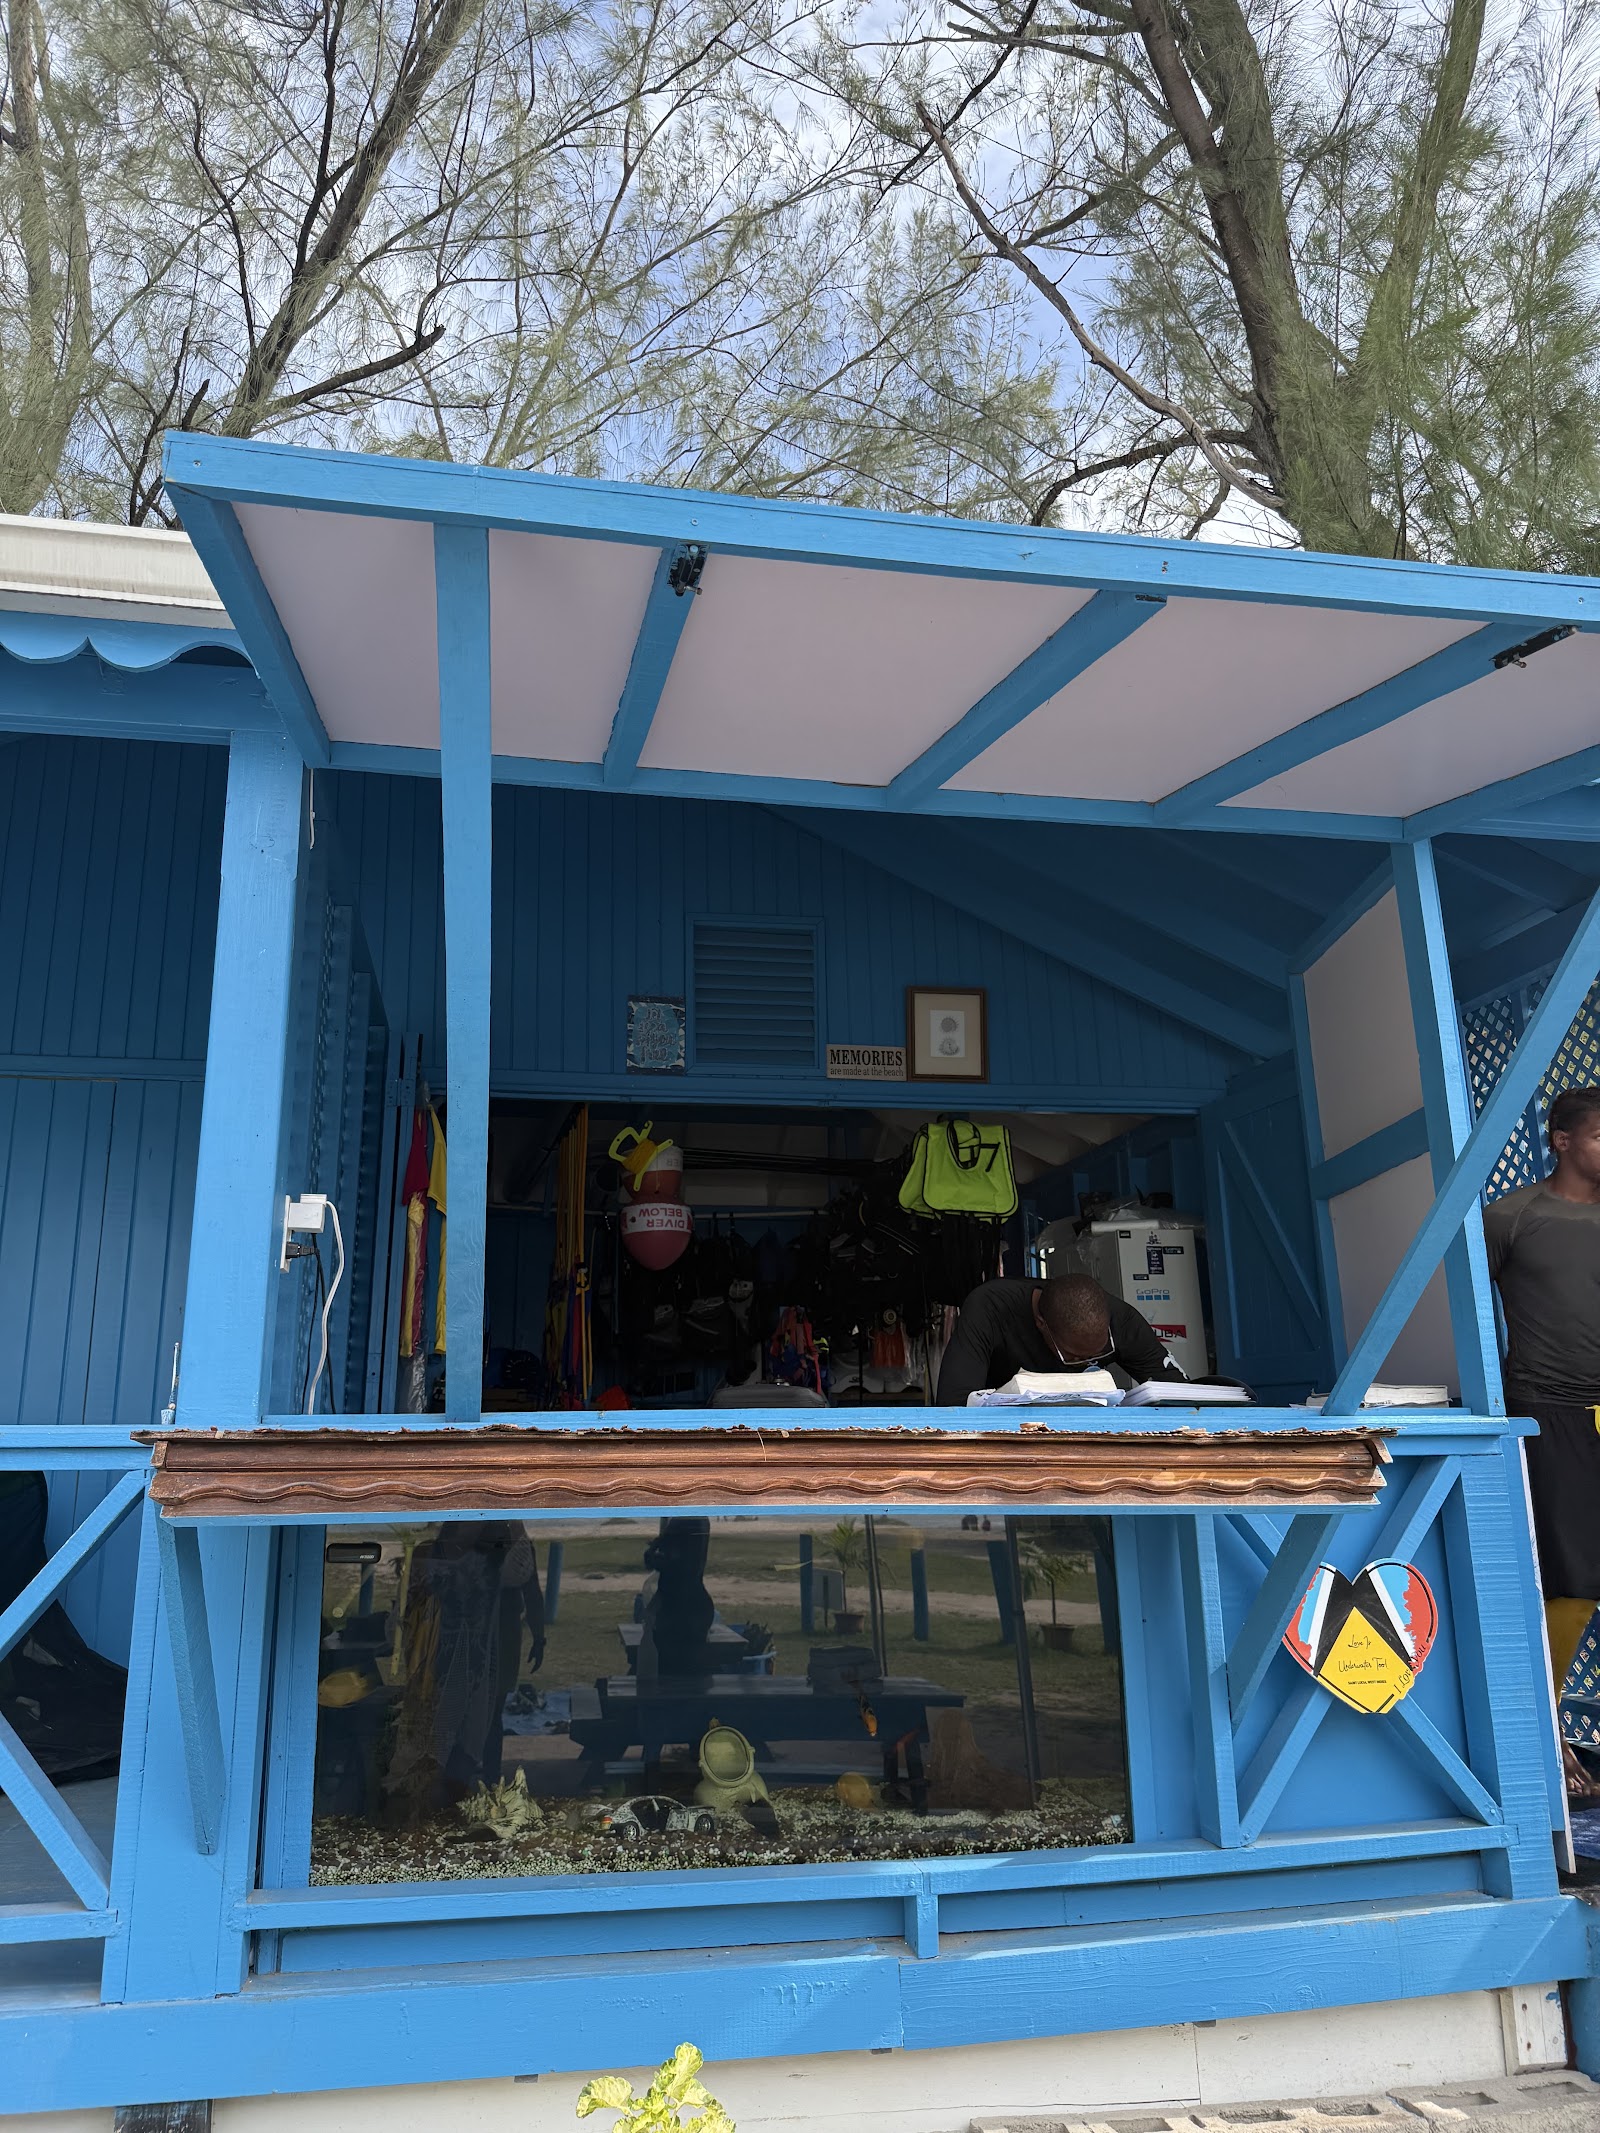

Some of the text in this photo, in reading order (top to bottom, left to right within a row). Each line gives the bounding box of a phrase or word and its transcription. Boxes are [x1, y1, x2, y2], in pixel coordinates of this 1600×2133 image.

[829, 1049, 903, 1067] MEMORIES
[830, 1066, 904, 1077] are made at the beach
[638, 1207, 683, 1218] BELOW
[646, 1219, 685, 1229] DIVER
[1154, 1329, 1184, 1338] UBA
